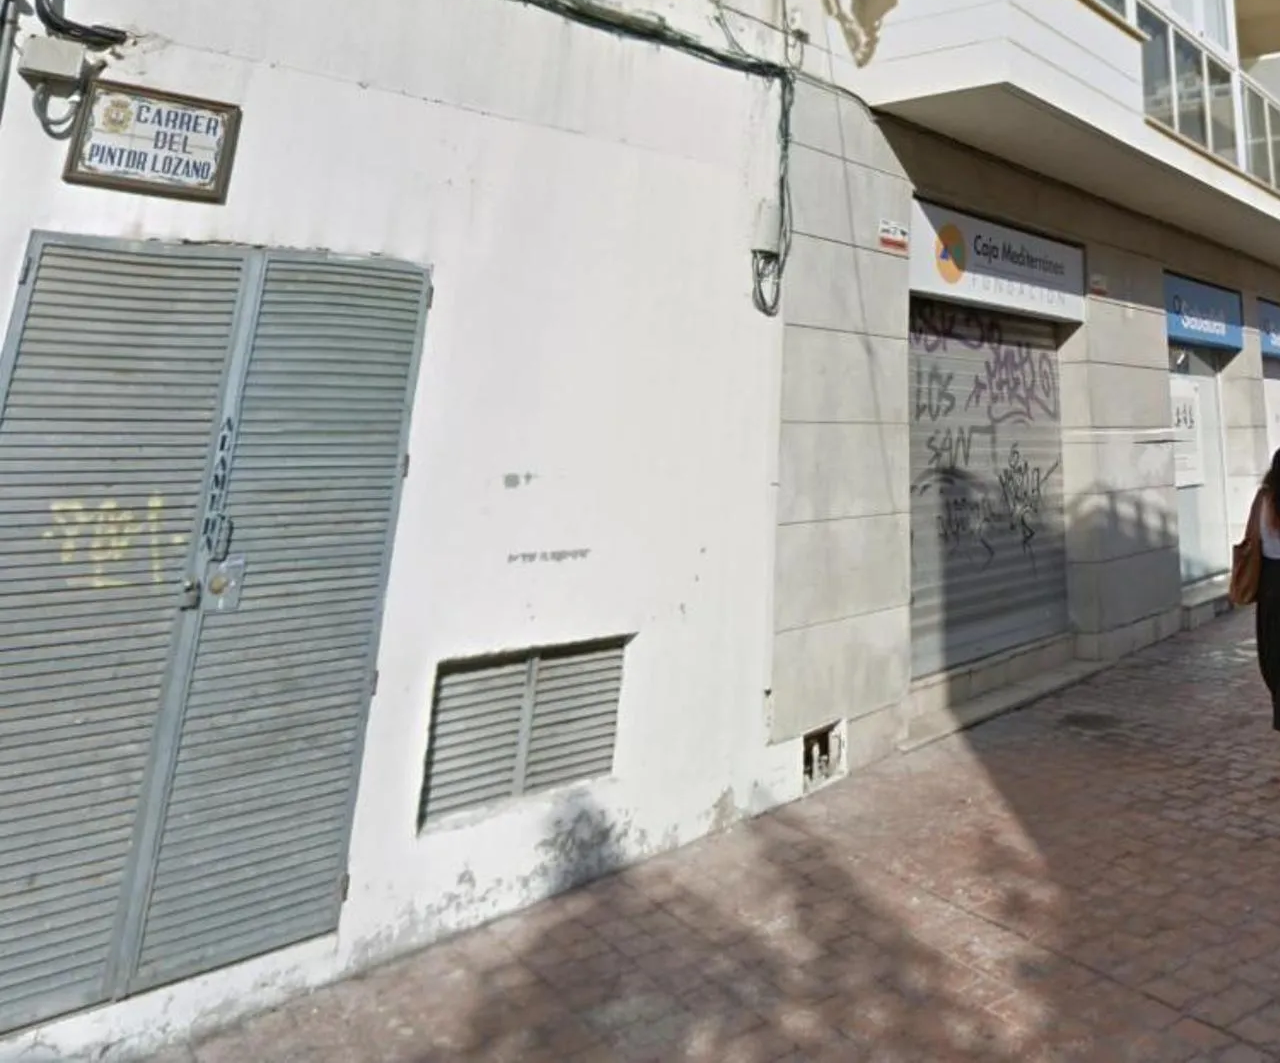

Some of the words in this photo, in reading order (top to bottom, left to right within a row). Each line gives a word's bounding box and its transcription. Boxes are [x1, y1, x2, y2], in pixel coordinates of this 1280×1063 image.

[135, 104, 218, 136] CARRER
[153, 130, 192, 154] DEL
[89, 144, 148, 171] PINTOR
[151, 156, 212, 179] LOZANO
[973, 235, 999, 265] Caja
